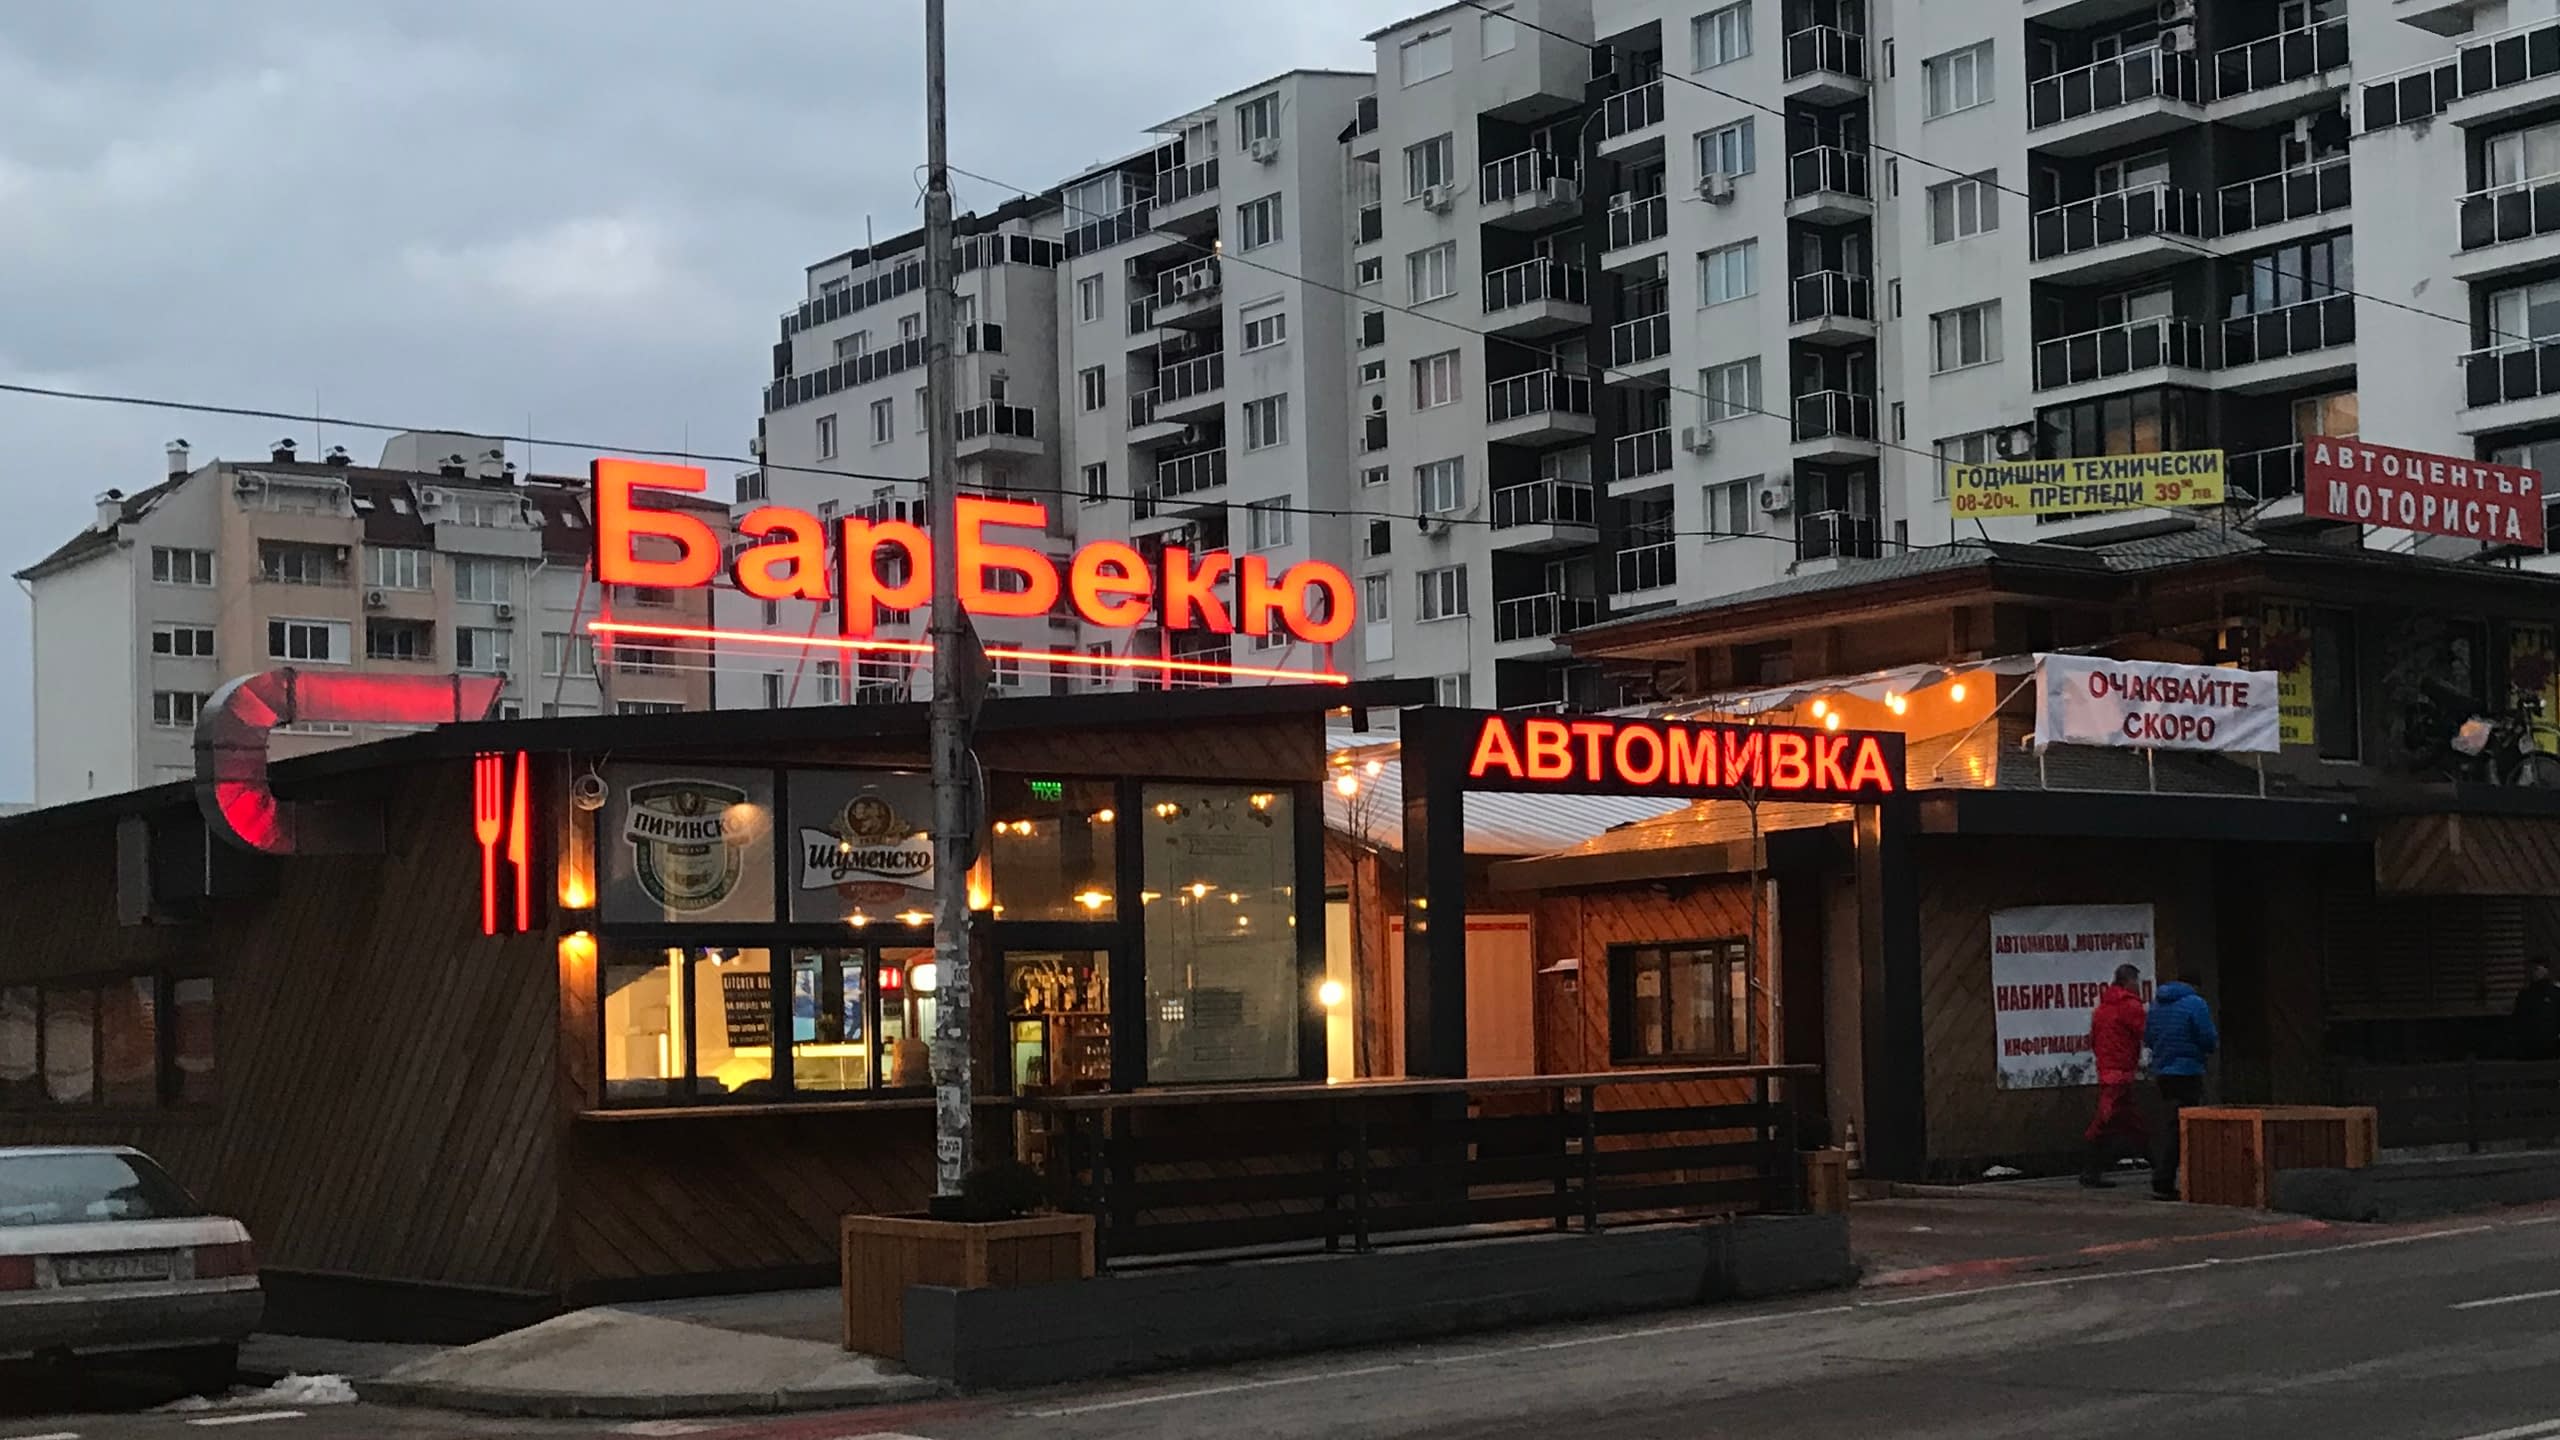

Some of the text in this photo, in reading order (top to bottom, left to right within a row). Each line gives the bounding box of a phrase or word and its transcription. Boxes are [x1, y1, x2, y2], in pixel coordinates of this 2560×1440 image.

[1955, 452, 2219, 490] ГОДИШНИ ТЕХНИЧЕСКИ
[2314, 443, 2534, 497] АВТОЦЕНТЪР
[2029, 481, 2144, 508] ПРЕГЛЕДИ
[2328, 479, 2523, 541] МОТОРИСТА
[590, 457, 1357, 644] БарБекю
[2088, 670, 2249, 708] ОЧАКВАЙТЕ
[2123, 711, 2216, 742] СКОРО
[1468, 716, 1894, 792] АВТОМИВКА
[1997, 984, 2065, 1011] НАБИРА
